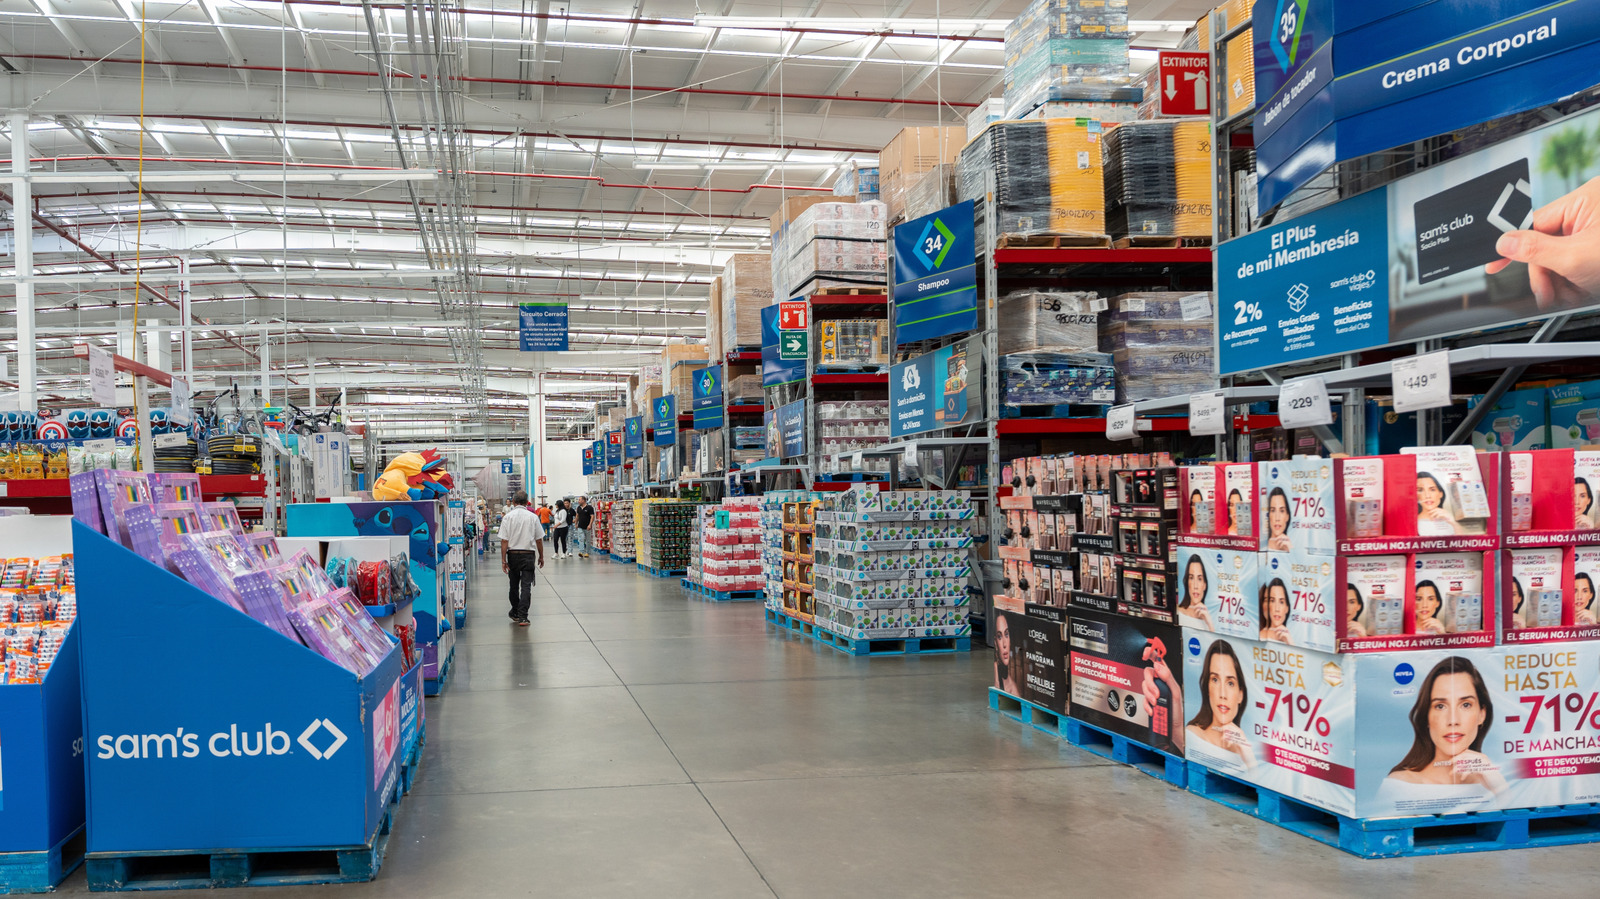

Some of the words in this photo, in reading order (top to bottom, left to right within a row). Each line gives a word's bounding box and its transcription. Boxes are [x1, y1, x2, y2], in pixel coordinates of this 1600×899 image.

[1280, 2, 1296, 43] 35
[1382, 58, 1450, 89] Crema
[1457, 17, 1557, 66] Corporal
[1162, 56, 1208, 68] EXTINTOR
[1282, 93, 1290, 108] de
[1291, 67, 1316, 100] tocador
[1420, 223, 1449, 242] sam's
[1450, 213, 1474, 231] club
[925, 234, 942, 254] 34
[1272, 231, 1284, 250] El
[1286, 224, 1317, 246] Plus
[1237, 262, 1254, 279] de
[1256, 254, 1273, 274] mi
[1275, 228, 1360, 268] Membresía
[918, 278, 950, 291] Shampoo
[1234, 300, 1263, 326] 2%
[1333, 300, 1373, 316] Beneficios
[1334, 311, 1373, 326] exclusivos
[1291, 469, 1318, 479] REDUCE
[1291, 482, 1319, 493] HASTA
[1292, 497, 1326, 518] 71%
[1292, 521, 1300, 529] DE
[1178, 535, 1183, 543] EL
[1215, 538, 1230, 546] NIVEL
[1341, 543, 1353, 552] EL
[1354, 542, 1388, 551] SERUM
[1390, 541, 1412, 550] NO.1
[1412, 541, 1420, 549] A
[1421, 540, 1448, 549] NIVEL
[1506, 536, 1517, 544] EL
[1518, 534, 1548, 543] SERUM
[1550, 534, 1569, 543] NO.1
[1570, 534, 1577, 542] A
[1218, 572, 1239, 581] REDUCE
[1291, 564, 1318, 574] REDUCE
[1218, 584, 1240, 594] HASTA
[1291, 577, 1319, 588] HASTA
[1076, 596, 1110, 606] MAYBELLINE
[1218, 595, 1245, 616] 71%
[1292, 590, 1326, 615] 71%
[1291, 614, 1299, 622] DE
[1507, 632, 1517, 641] EL
[1518, 631, 1549, 640] SERUM
[1550, 631, 1570, 639] NO.1
[1571, 630, 1577, 638] A
[1340, 642, 1352, 650] EL
[1353, 640, 1387, 649] SERUM
[1388, 639, 1410, 648] NO.1
[1411, 639, 1418, 647] A
[1419, 637, 1446, 646] NIVEL
[1026, 651, 1055, 667] PANORAMA
[1253, 647, 1305, 669] REDUCE
[1504, 652, 1577, 670] REDUCE
[1092, 661, 1108, 671] SPRAY
[1254, 663, 1306, 690] HASTA
[1504, 671, 1578, 692] HASTA
[1256, 687, 1331, 737] -71%
[1505, 692, 1600, 735] -71%
[1254, 723, 1269, 738] DE
[97, 727, 200, 760] sam's
[208, 722, 291, 756] club
[1504, 740, 1524, 754] DE
[1275, 748, 1281, 756] O
[1281, 750, 1288, 759] TE
[1288, 751, 1330, 771] DEVOLVEMOS
[1275, 756, 1284, 765] TU
[1284, 758, 1306, 772] DINERO
[1535, 759, 1542, 767] O
[1535, 768, 1546, 776] TU
[1547, 766, 1577, 775] DINERO
